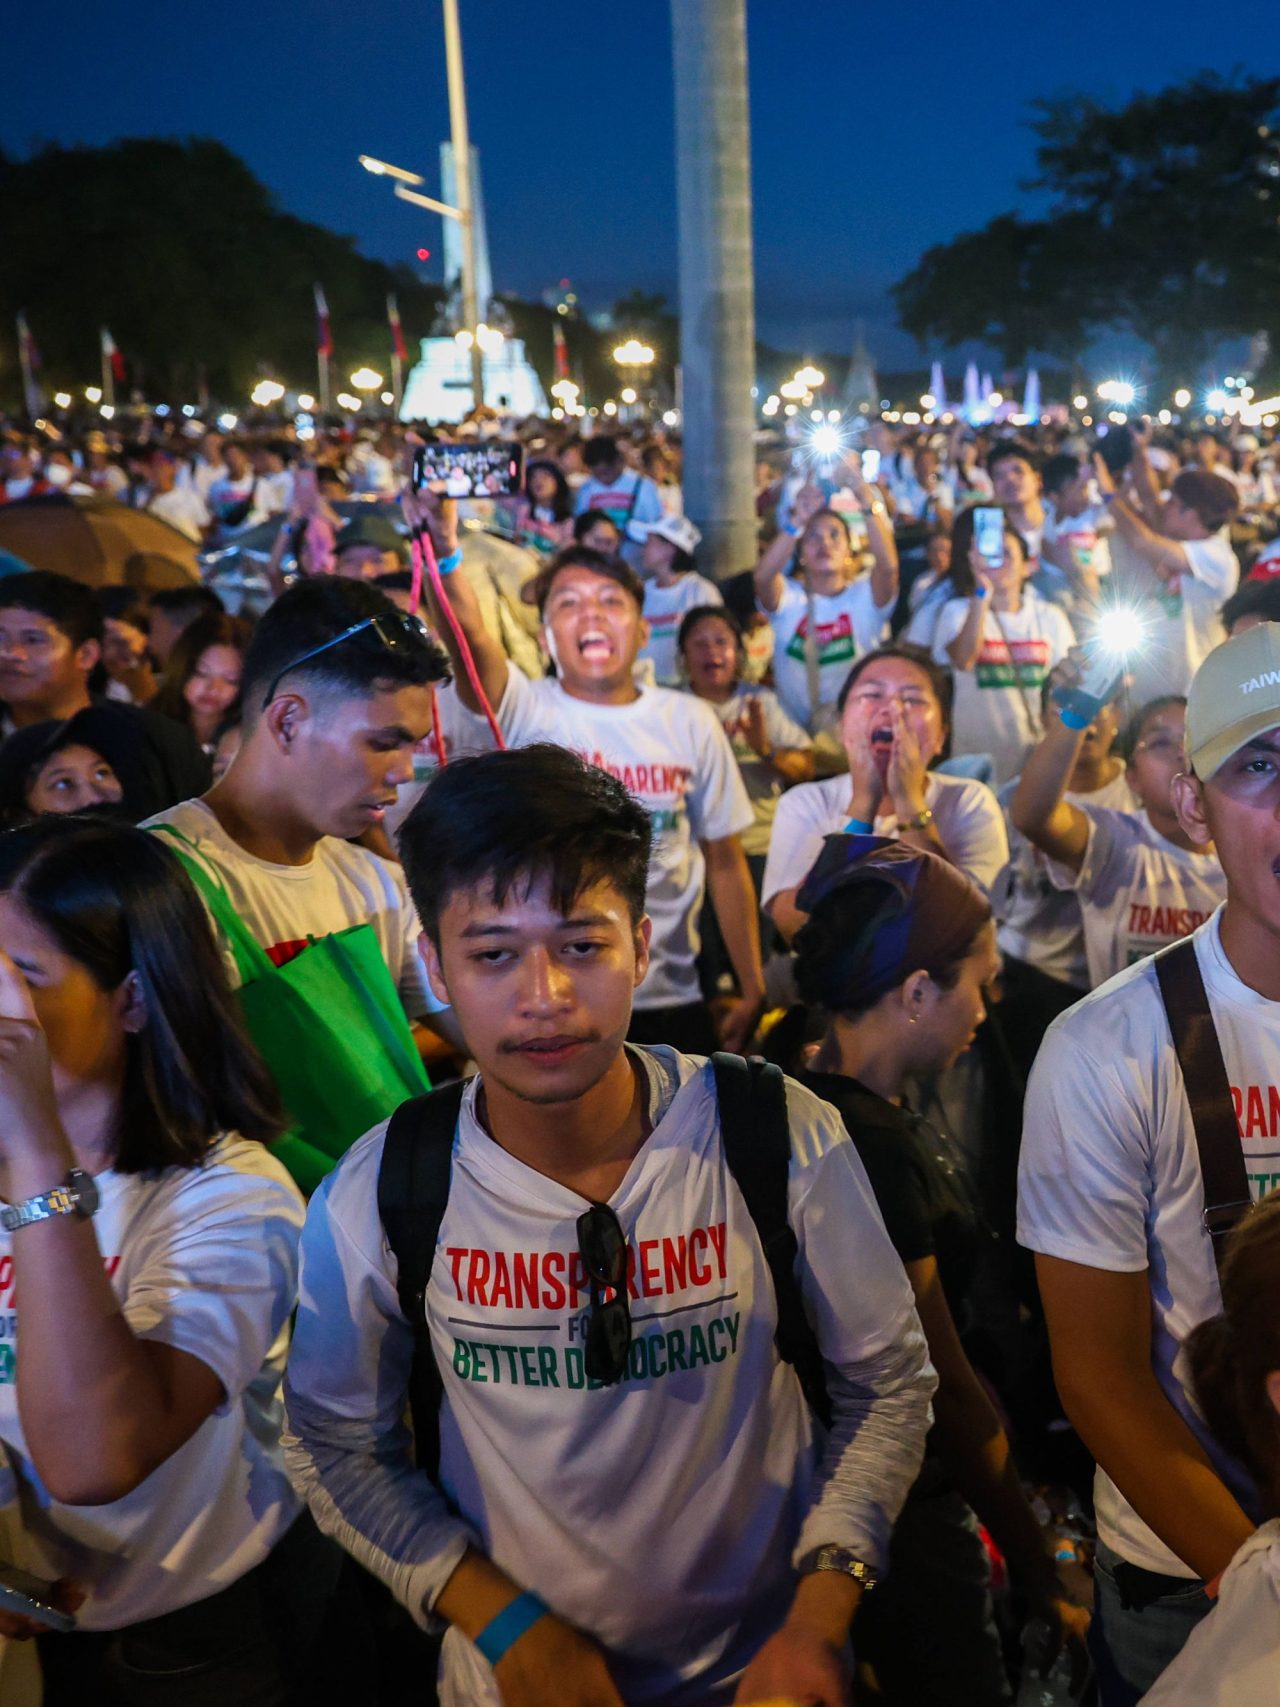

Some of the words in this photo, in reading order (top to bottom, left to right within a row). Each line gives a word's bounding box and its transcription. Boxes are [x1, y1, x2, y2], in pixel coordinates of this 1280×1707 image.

[1129, 903, 1212, 935] TRANSP
[446, 1222, 728, 1310] TRANSPRENCY
[452, 1337, 560, 1388] BETTER
[564, 1311, 741, 1391] DOCRACY
